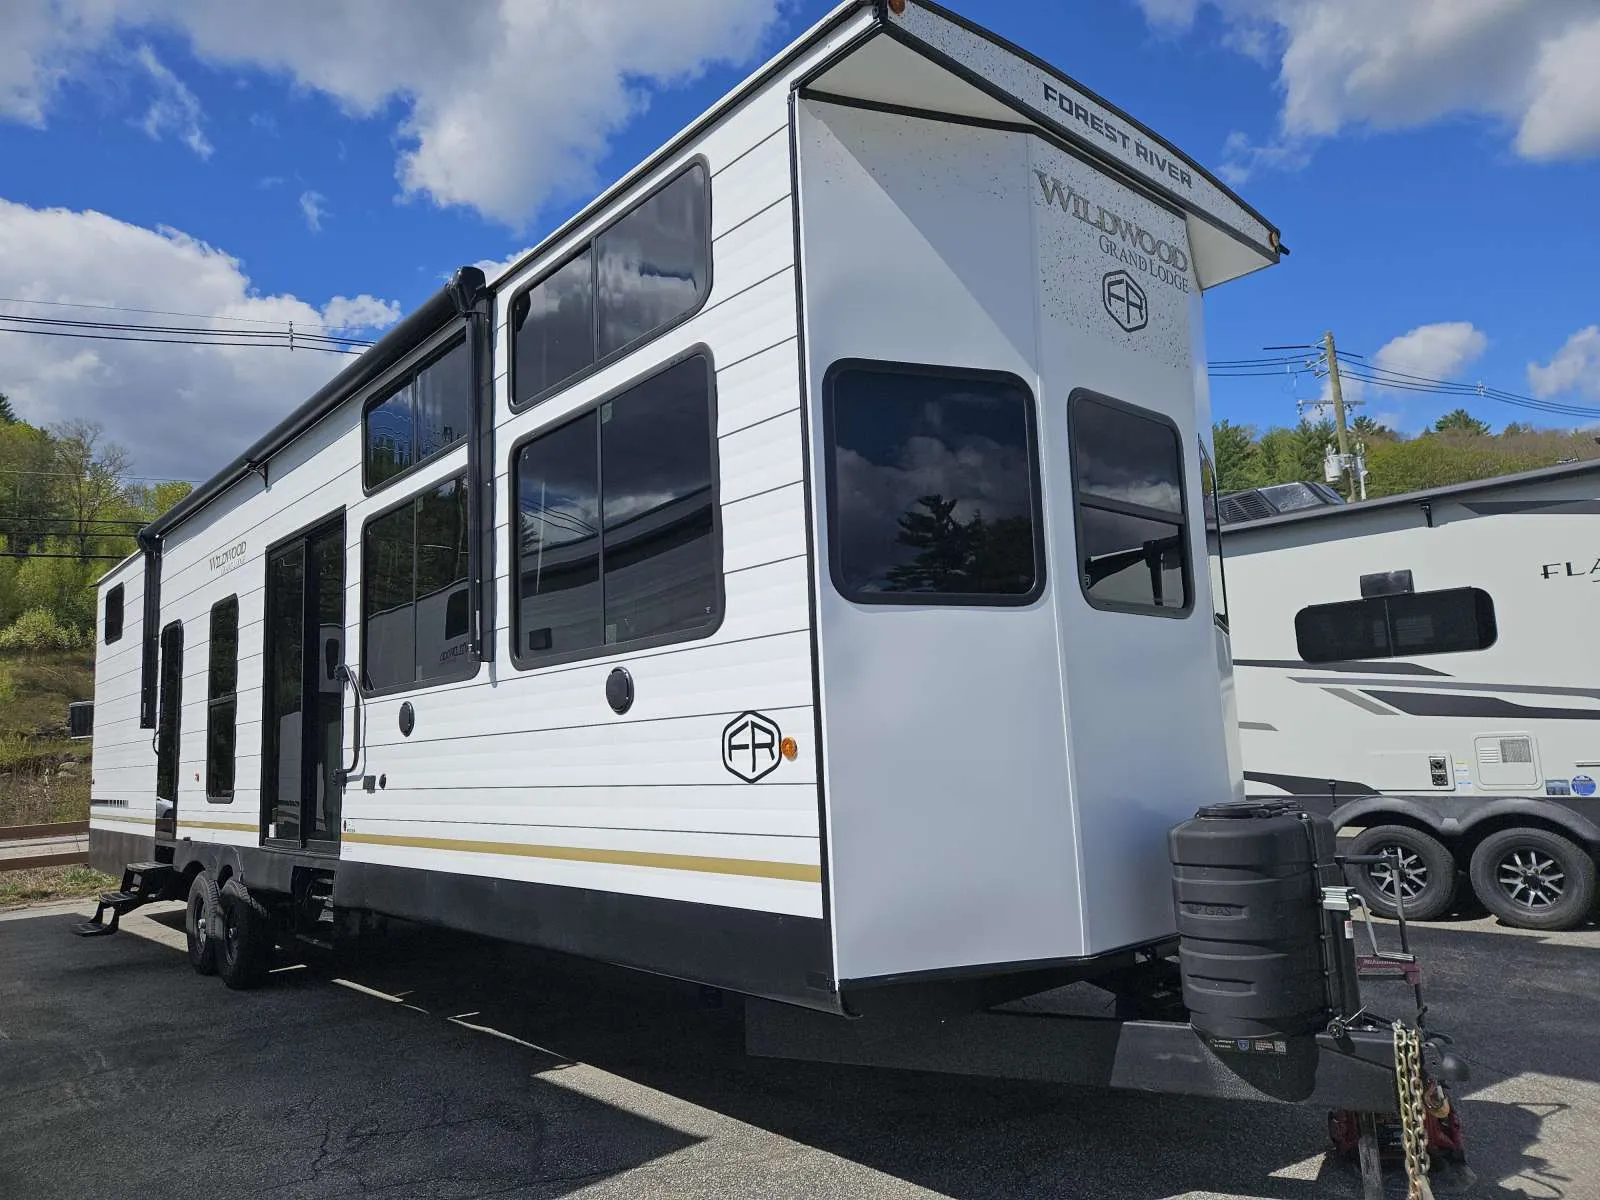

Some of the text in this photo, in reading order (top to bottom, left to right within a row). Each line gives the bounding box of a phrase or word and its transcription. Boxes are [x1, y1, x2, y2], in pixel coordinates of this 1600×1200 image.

[1043, 82, 1193, 189] FOREST RIVER
[1033, 168, 1188, 272] WILDWOOD
[1099, 234, 1189, 294] GRAND LODGE
